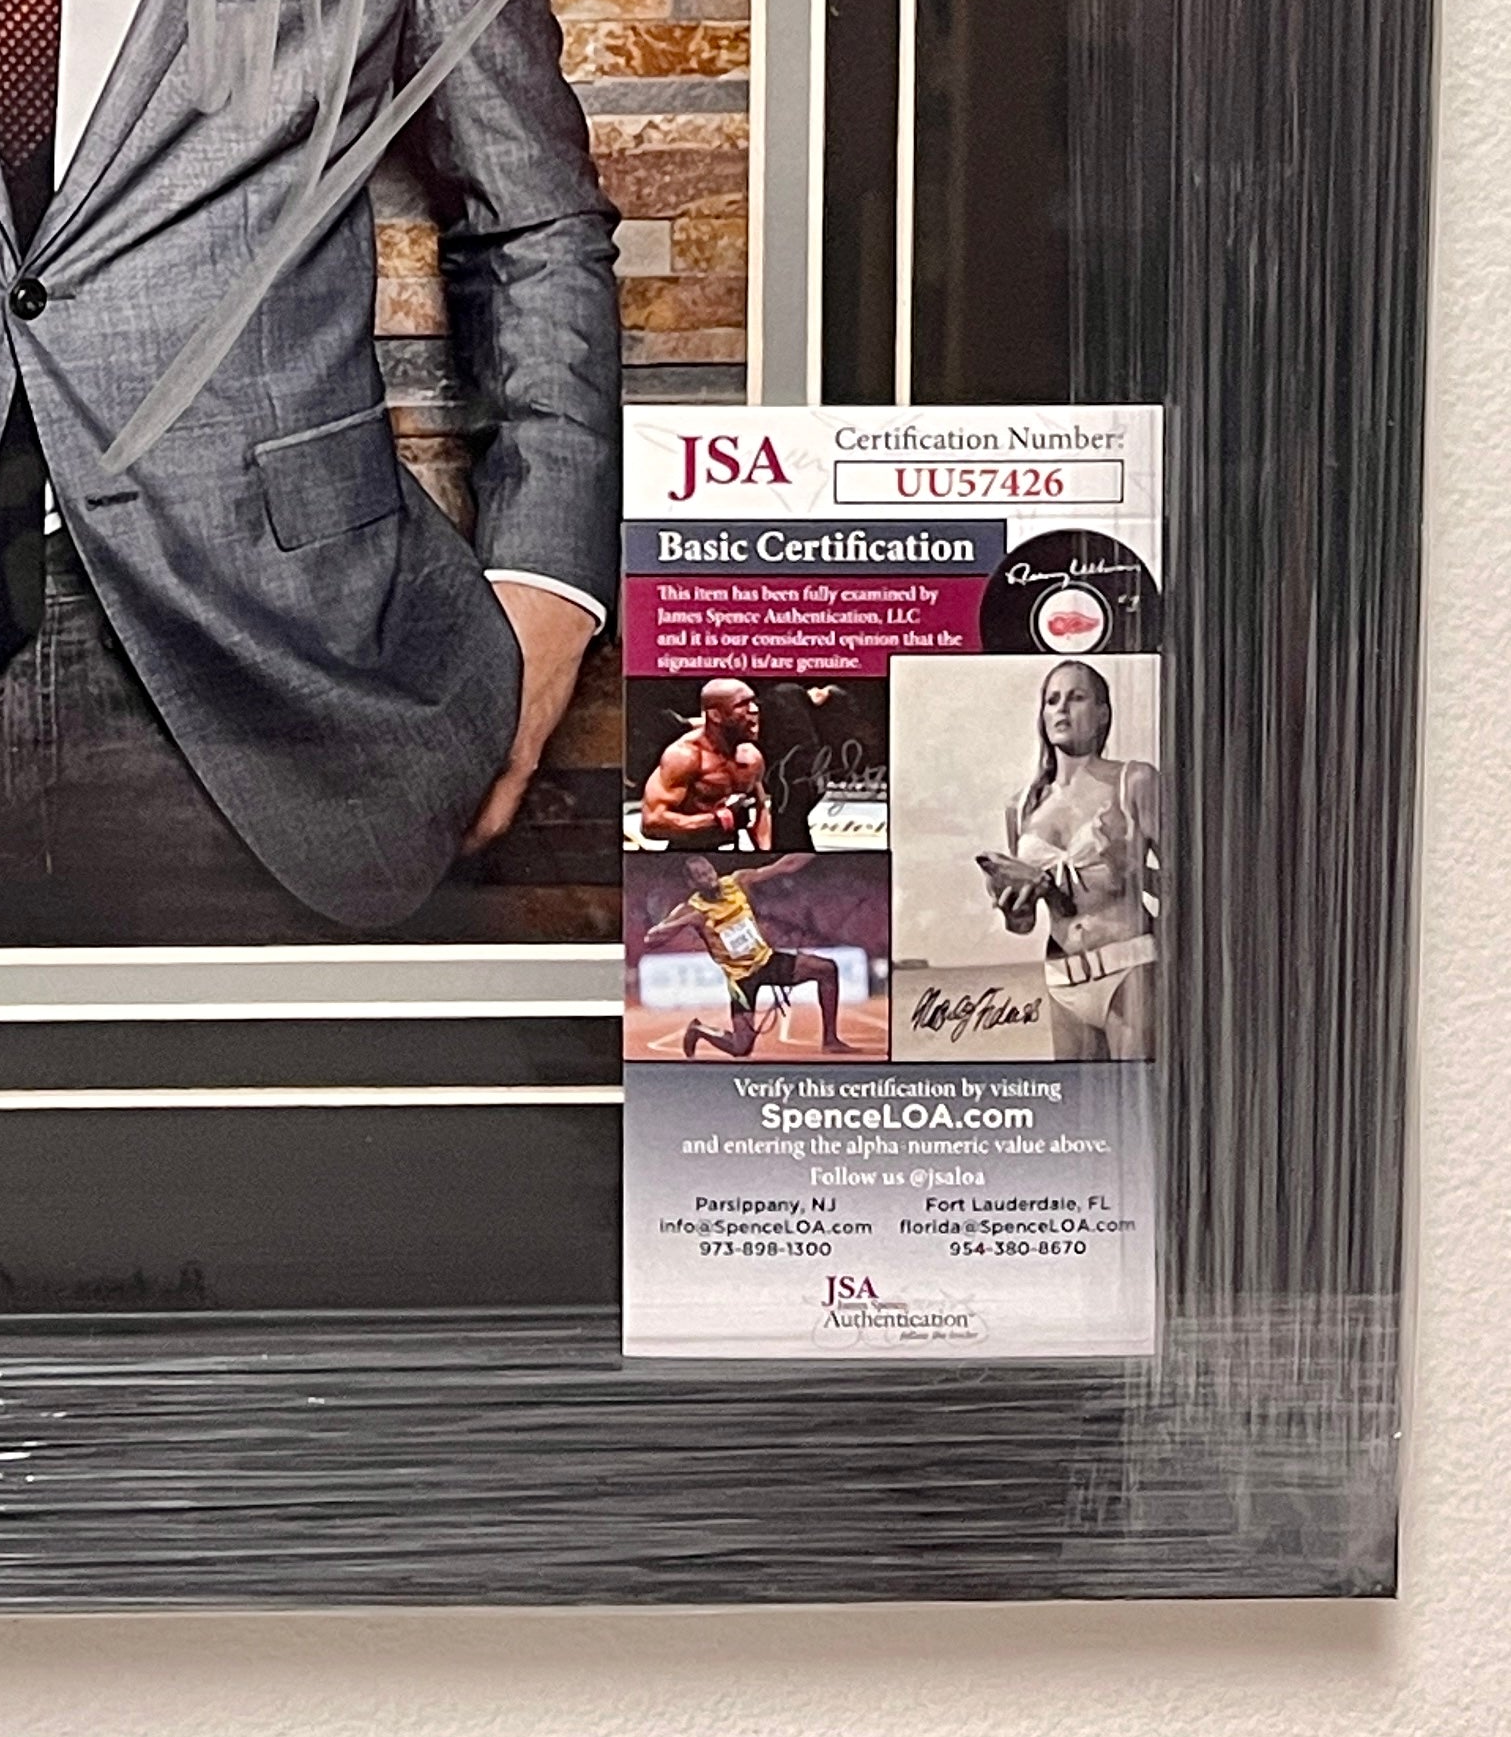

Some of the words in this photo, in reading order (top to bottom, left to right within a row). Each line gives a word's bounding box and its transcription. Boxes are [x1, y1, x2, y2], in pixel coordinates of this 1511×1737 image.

[835, 425, 1000, 451] Certification
[1008, 425, 1125, 451] Number:
[668, 435, 792, 501] JSA
[895, 468, 1064, 497] UU57426
[657, 531, 749, 562] Basic
[756, 530, 975, 562] Certification
[656, 584, 690, 601] This
[694, 585, 728, 601] item
[731, 585, 759, 601] has
[761, 585, 800, 601] been
[803, 585, 838, 605] fully
[840, 585, 916, 602] examined
[919, 585, 939, 605] by
[657, 607, 703, 626] James
[706, 607, 761, 628] Spence
[763, 607, 883, 625] Authentication,
[886, 608, 921, 624] LLC
[656, 630, 687, 646] and
[690, 631, 701, 646] it
[704, 631, 719, 646] is
[721, 633, 749, 646] our
[751, 630, 836, 646] considered
[839, 631, 900, 650] opinion
[903, 630, 934, 646] that
[937, 630, 963, 646] the
[657, 652, 748, 673] signature(s)
[750, 653, 794, 669] is/are
[796, 654, 862, 673] genuine.
[733, 1077, 794, 1103] Verify
[798, 1078, 836, 1097] this
[839, 1076, 956, 1097] certification
[962, 1077, 986, 1103] by
[990, 1078, 1062, 1102] visiting
[761, 1103, 1034, 1133] SpenceLOA.com
[682, 1134, 719, 1154] and
[723, 1136, 806, 1160] entering
[810, 1135, 841, 1154] the
[994, 1135, 1045, 1154] value
[1049, 1134, 1111, 1154] above.
[810, 1166, 877, 1185] Follow
[882, 1172, 905, 1185] us
[909, 1166, 985, 1190] @jsaloa
[695, 1197, 805, 1214] Parsippany,
[811, 1197, 837, 1212] NJ
[925, 1197, 966, 1212] Fort
[972, 1196, 1081, 1213] Lauderdale,
[1088, 1196, 1111, 1211] FL
[659, 1218, 873, 1236] info@SpenceLOA.com
[900, 1217, 1136, 1237] florida@SpenceLOA.com
[699, 1241, 832, 1256] 973-898-1300
[949, 1240, 1087, 1256] 954-380-8670
[820, 1275, 879, 1307] JSA
